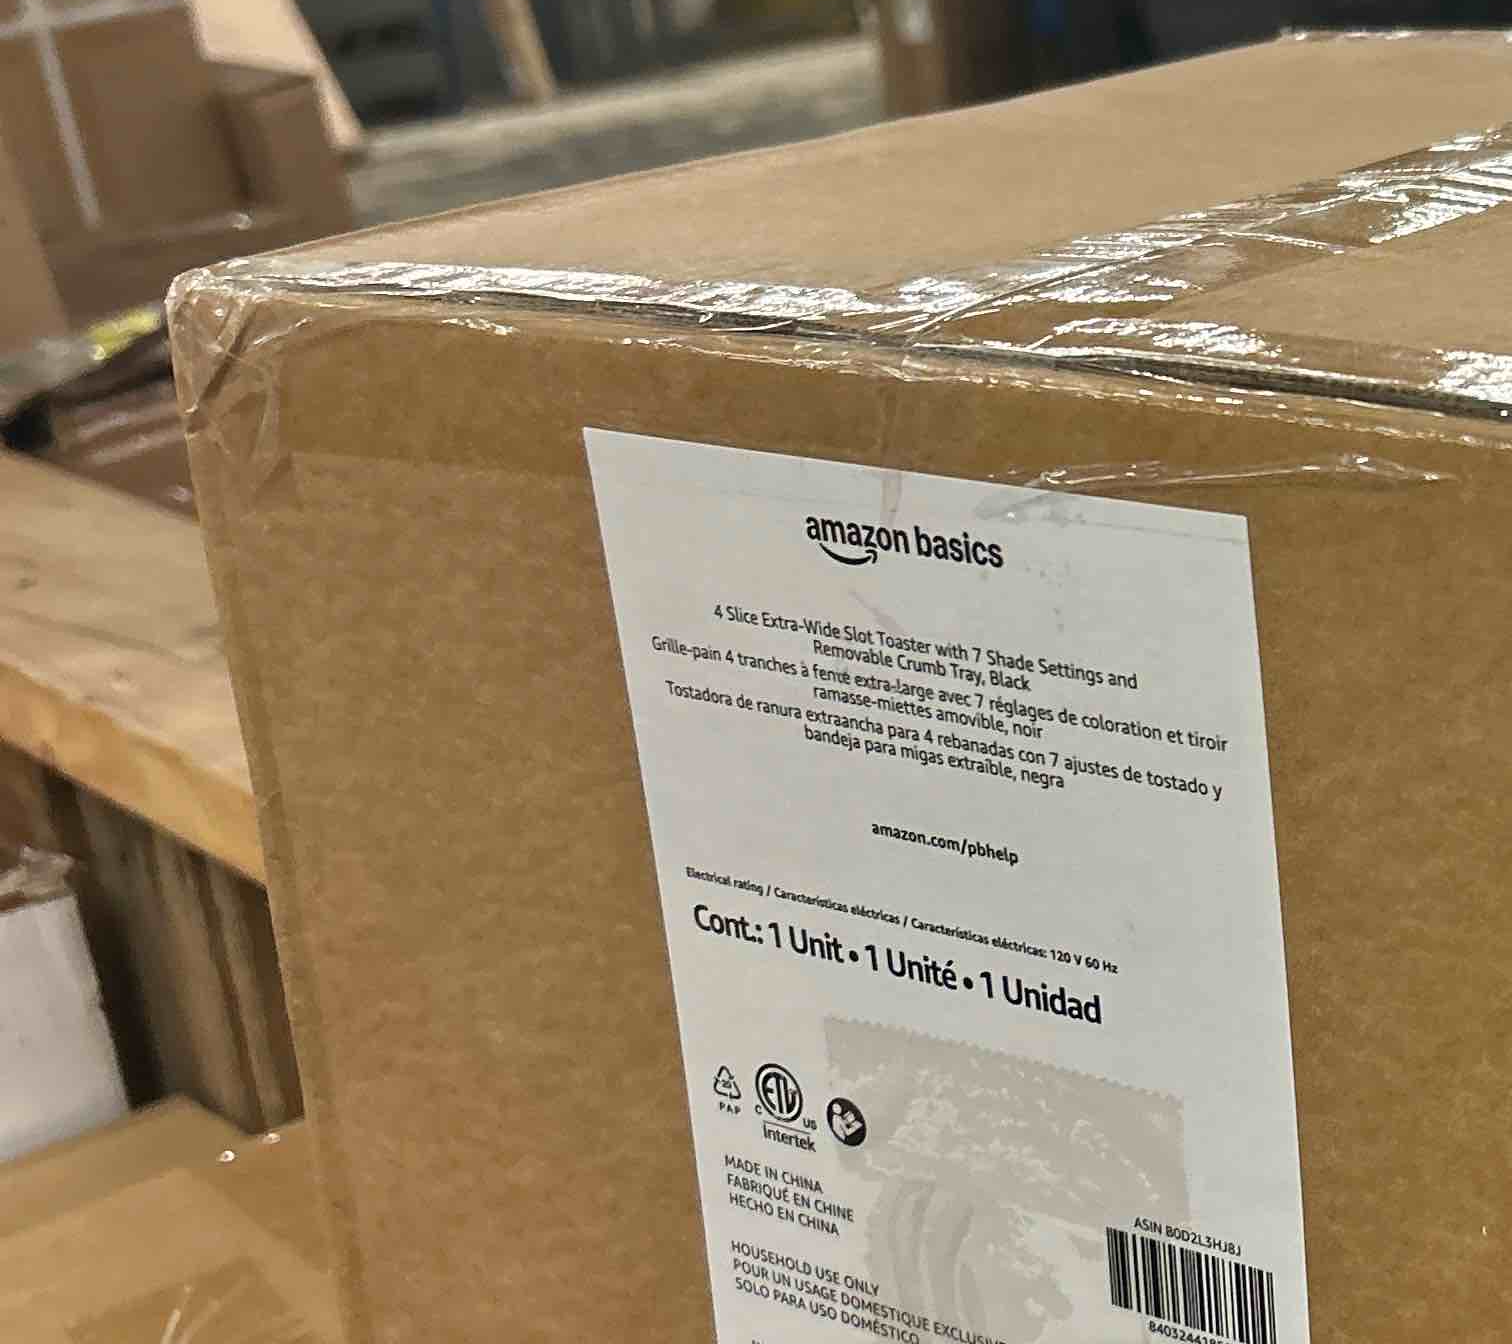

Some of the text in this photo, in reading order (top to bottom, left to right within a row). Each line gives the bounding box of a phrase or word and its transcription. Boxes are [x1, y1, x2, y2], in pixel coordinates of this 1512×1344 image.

[804, 515, 1004, 569] amazon basics
[713, 603, 1138, 690] 4 Slice Extra-Wide Slot Toaster with 7 Shade Settings and
[812, 638, 1032, 692] Removable Crumb Tray, Black
[650, 635, 1228, 752] Grille-pain 4 tranches à fente extra-large avec 7 réglages de coloration et tiroir
[812, 686, 1044, 739] ramasse-miettes amovible, noir
[664, 679, 1223, 803] Tostadora de ranura extraancha para 4 rebanadas con 7 ajustes de tostado y
[803, 723, 862, 752] bandeja
[863, 738, 897, 757] para
[899, 744, 945, 767] migas
[1019, 768, 1065, 790] negra
[870, 822, 1019, 867] amazon.com/pbhelp
[685, 865, 732, 887] Electrical
[732, 878, 764, 897] rating
[1049, 948, 1072, 964] 120
[1072, 953, 1083, 967] V
[1083, 955, 1101, 971] 60
[1101, 959, 1119, 975] Hz
[692, 903, 1103, 1025] Cont.: 1 Unit 1 Unité 1 Unidad
[719, 1101, 743, 1116] PAP
[762, 1123, 818, 1153] Intertek
[723, 1153, 825, 1195] MADE IN CHINA
[726, 1172, 854, 1223] FABRIQUÉ EN CHINE
[728, 1191, 840, 1237] HECHO EN CHINA
[1132, 1216, 1242, 1257] ASIN B0D2L3HJ8J
[730, 1239, 880, 1297] HOUSEHOLD USE ONLY
[732, 1256, 771, 1281] POUR
[771, 1269, 792, 1289] UN
[793, 1277, 839, 1304] USAGE
[839, 1290, 931, 1333] DOMESTIQUE
[734, 1275, 771, 1299] SOLO
[771, 1287, 807, 1310] PARA
[808, 1299, 838, 1321] USO
